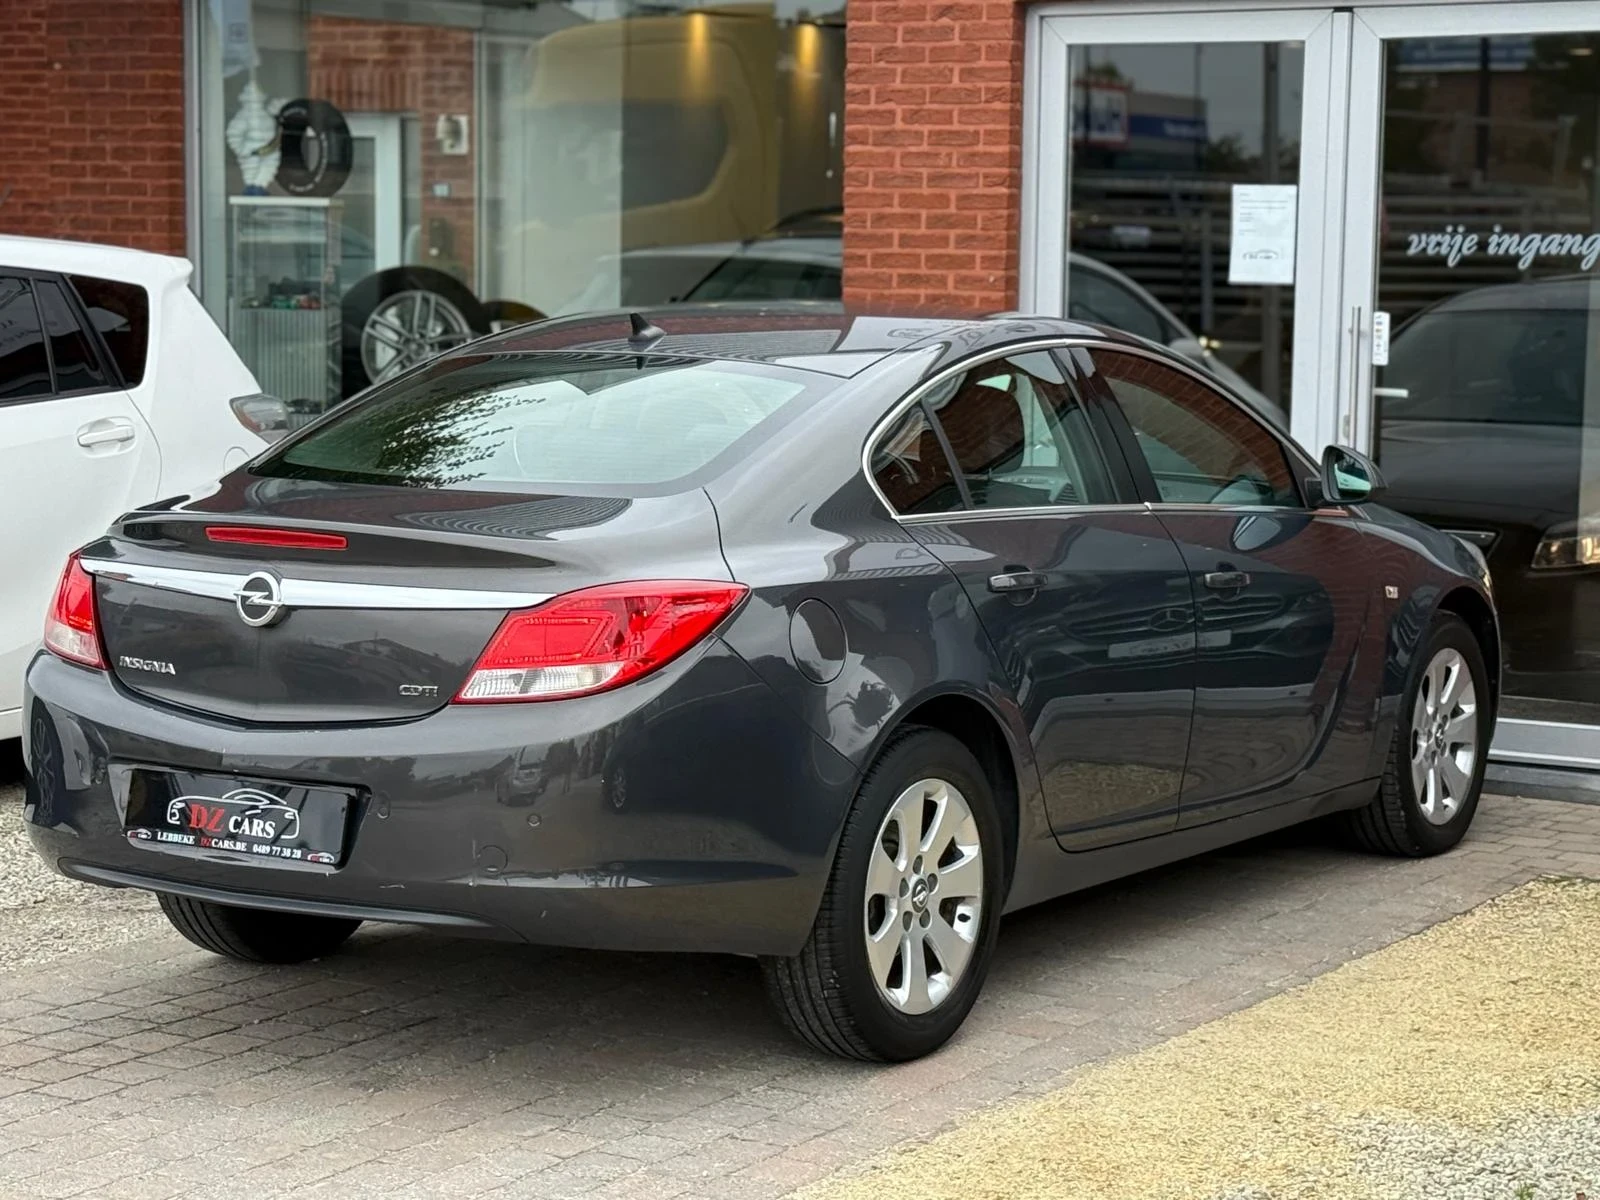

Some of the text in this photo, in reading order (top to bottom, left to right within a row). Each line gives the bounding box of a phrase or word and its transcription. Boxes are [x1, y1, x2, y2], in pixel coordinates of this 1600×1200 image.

[1407, 224, 1600, 271] vrije ingang
[119, 655, 176, 675] INSIGNIA
[399, 684, 438, 697] CDTI
[189, 804, 276, 839] DZ CARS
[157, 831, 195, 845] LEBBEKE
[252, 843, 271, 855] 0489
[271, 846, 281, 856] 77
[281, 847, 292, 858] 38
